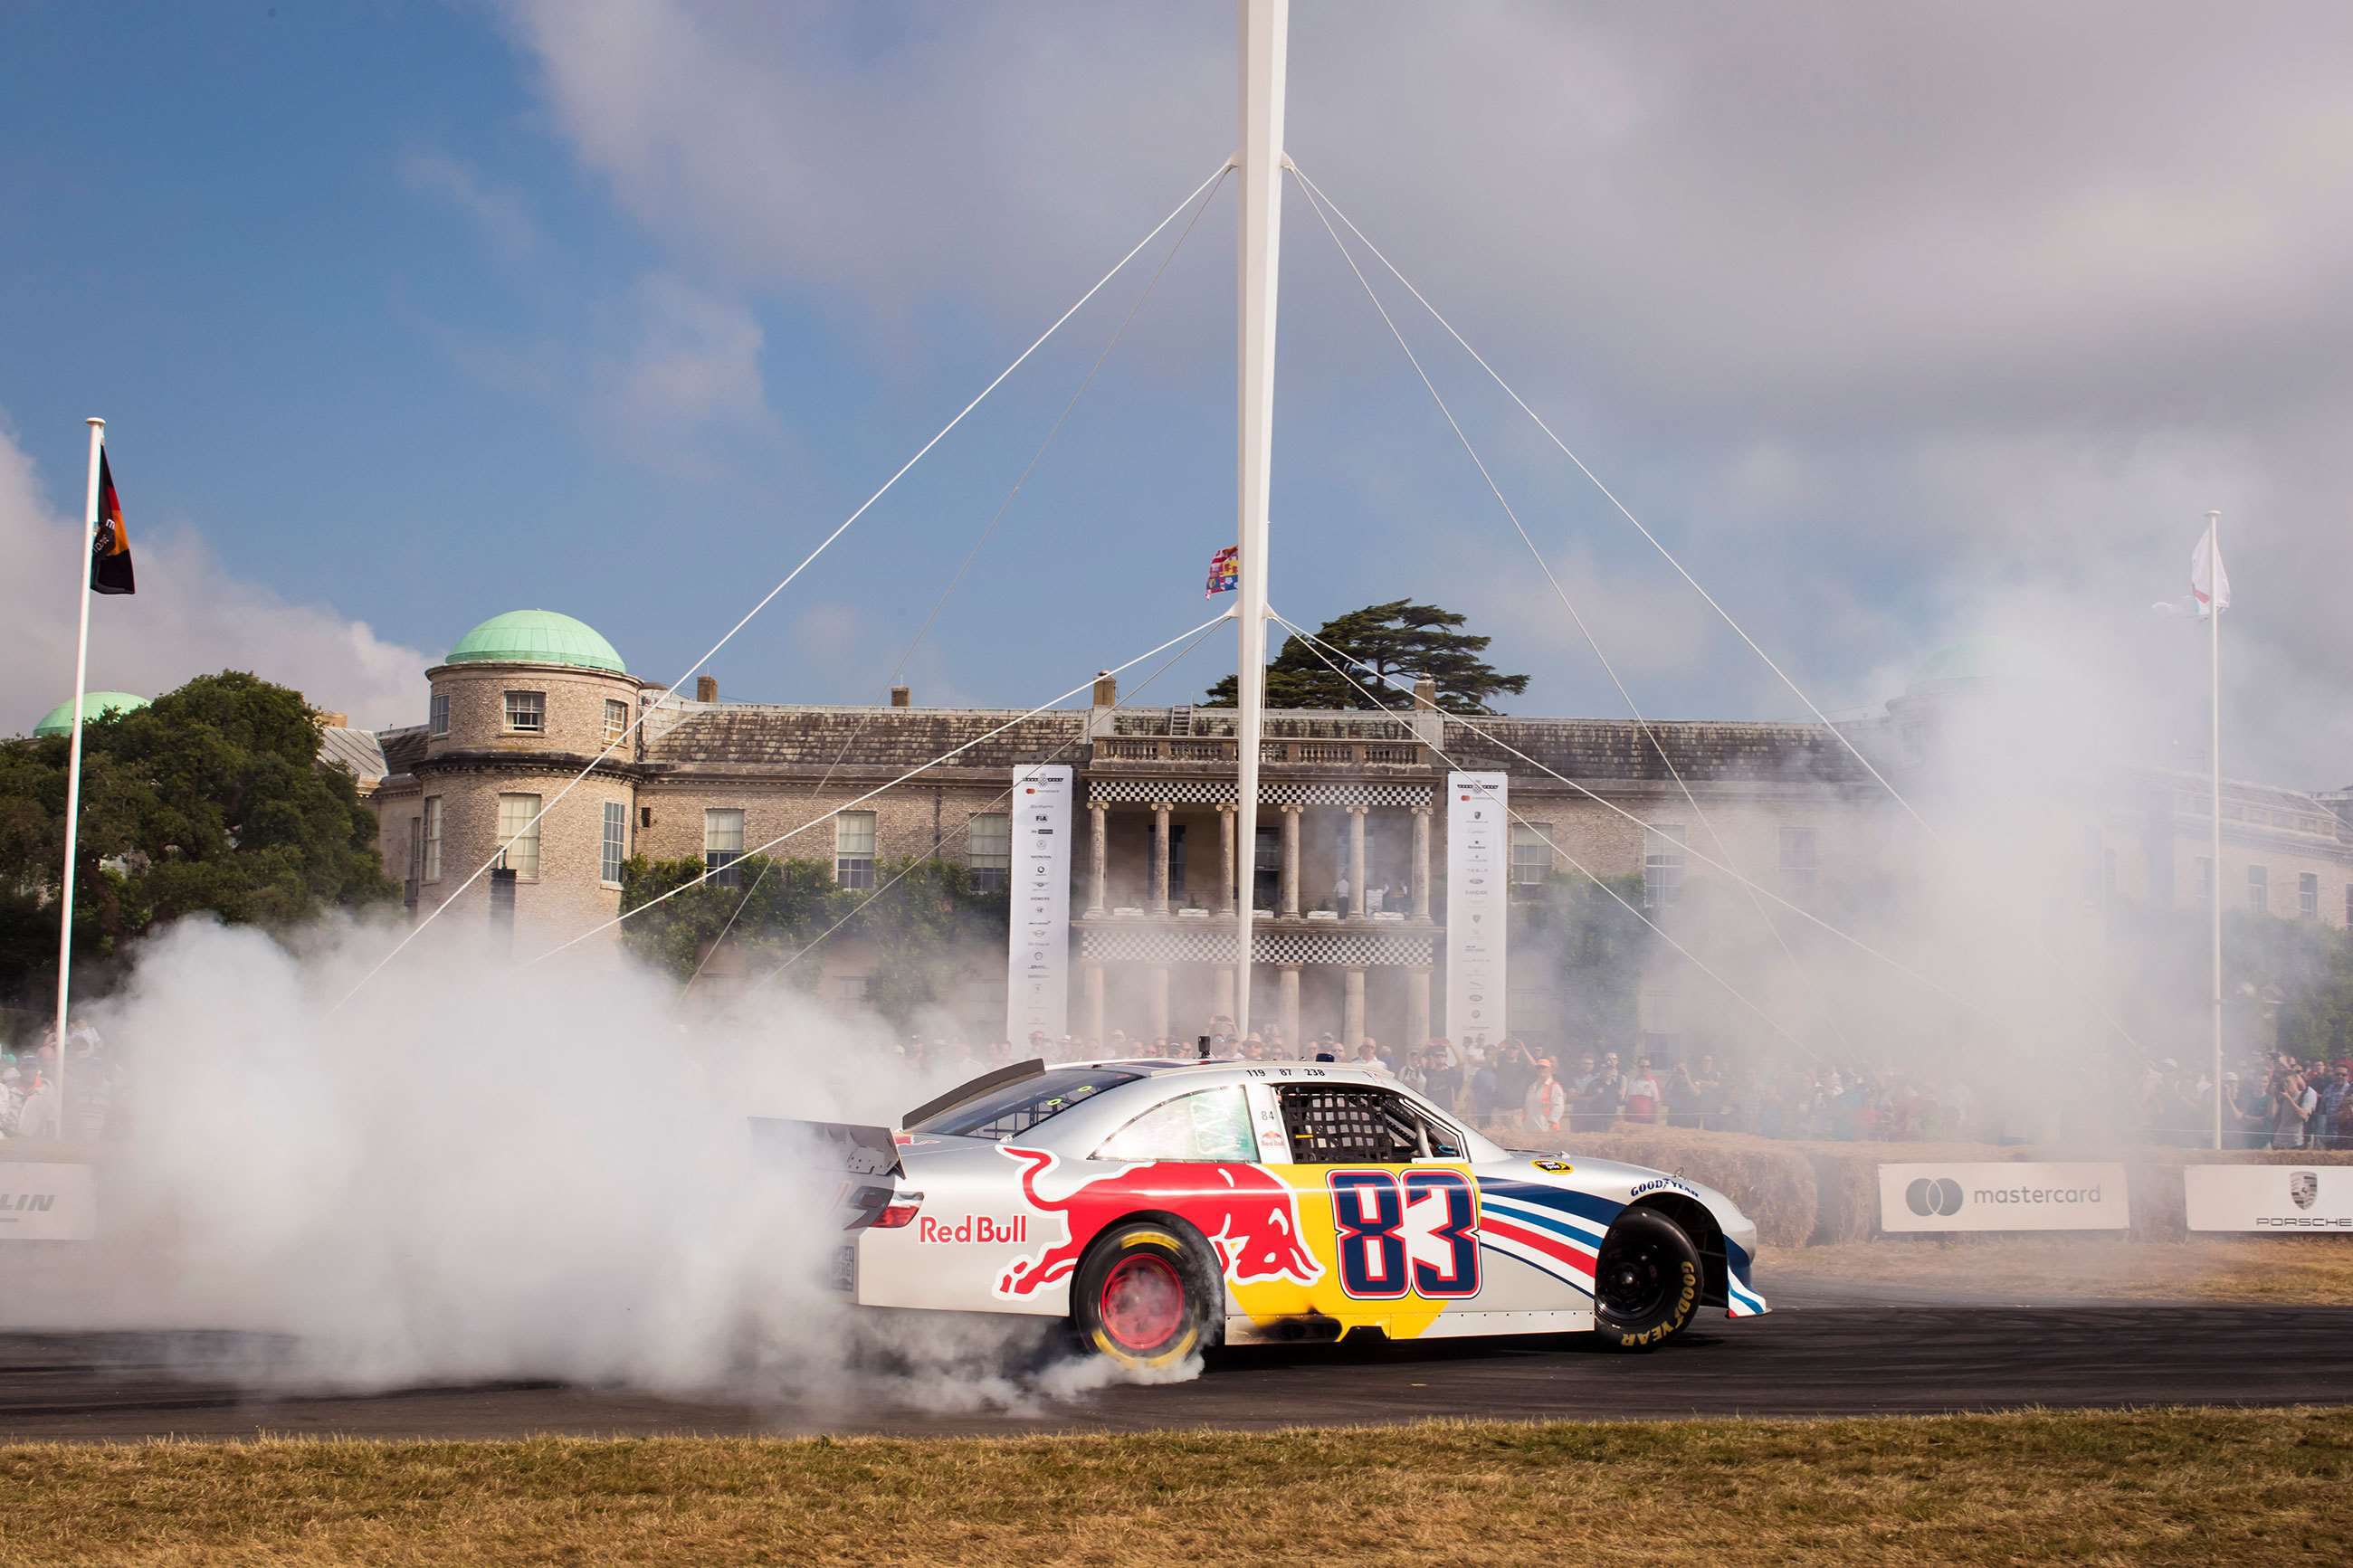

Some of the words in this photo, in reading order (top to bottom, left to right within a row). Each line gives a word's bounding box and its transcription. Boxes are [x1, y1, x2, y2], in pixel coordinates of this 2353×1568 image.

[1261, 1110, 1274, 1120] 84
[1974, 1183, 2101, 1202] mastercard
[919, 1215, 972, 1242] Red
[976, 1215, 1027, 1242] Bull
[2256, 1217, 2352, 1227] PORSCHE
[1325, 1168, 1482, 1300] 83
